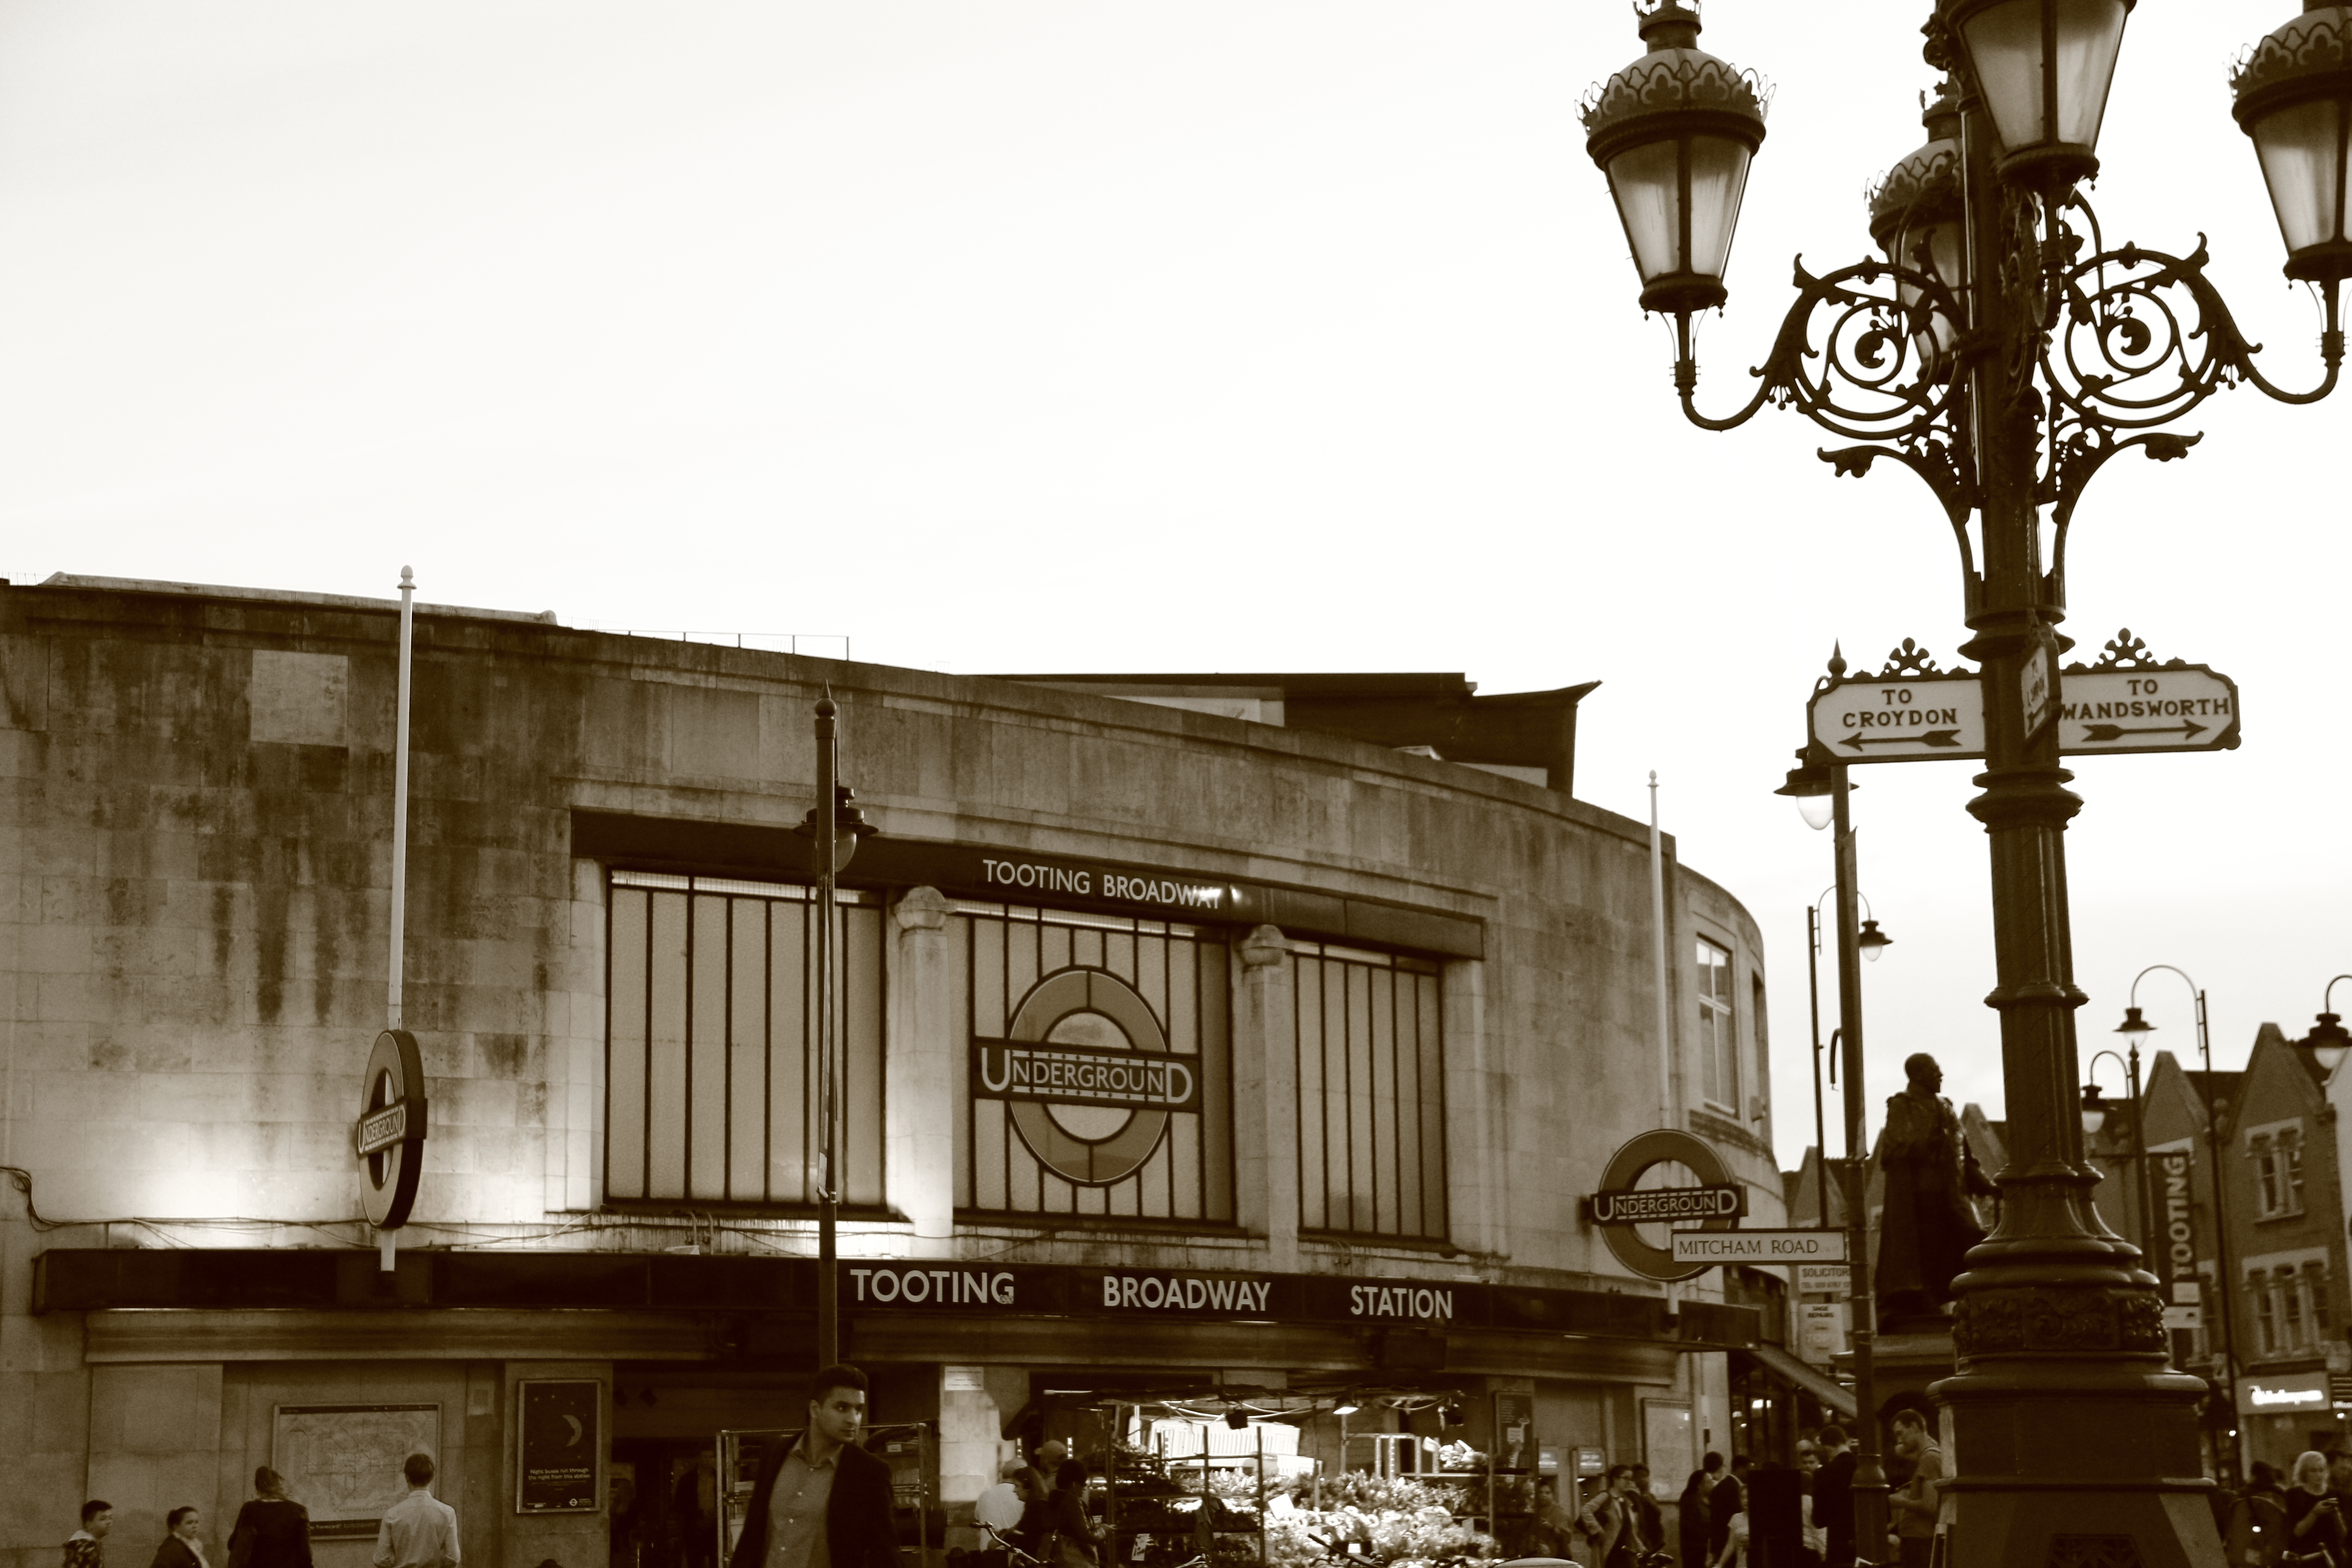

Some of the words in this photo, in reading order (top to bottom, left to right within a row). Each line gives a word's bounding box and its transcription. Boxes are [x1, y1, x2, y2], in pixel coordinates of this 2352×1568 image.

[1882, 689, 1912, 705] TO
[2127, 679, 2158, 695] TO
[1843, 708, 1957, 727] CROYDON
[2062, 698, 2229, 720] WANDSWORTH
[983, 859, 1090, 894] TOOTING
[1103, 874, 1222, 909] BROADWAY
[981, 1047, 1193, 1103] UNDERGROUND
[358, 1104, 406, 1154] UNDERGROUND
[1594, 1189, 1738, 1221] UNDERGROUND
[2162, 1157, 2193, 1278] TOOTING
[1678, 1240, 1762, 1255] MITCHAM
[1771, 1239, 1819, 1254] ROAD
[850, 1269, 1014, 1304] TOOTING
[1103, 1275, 1271, 1311] BROADWAY
[1351, 1285, 1453, 1319] STATION
